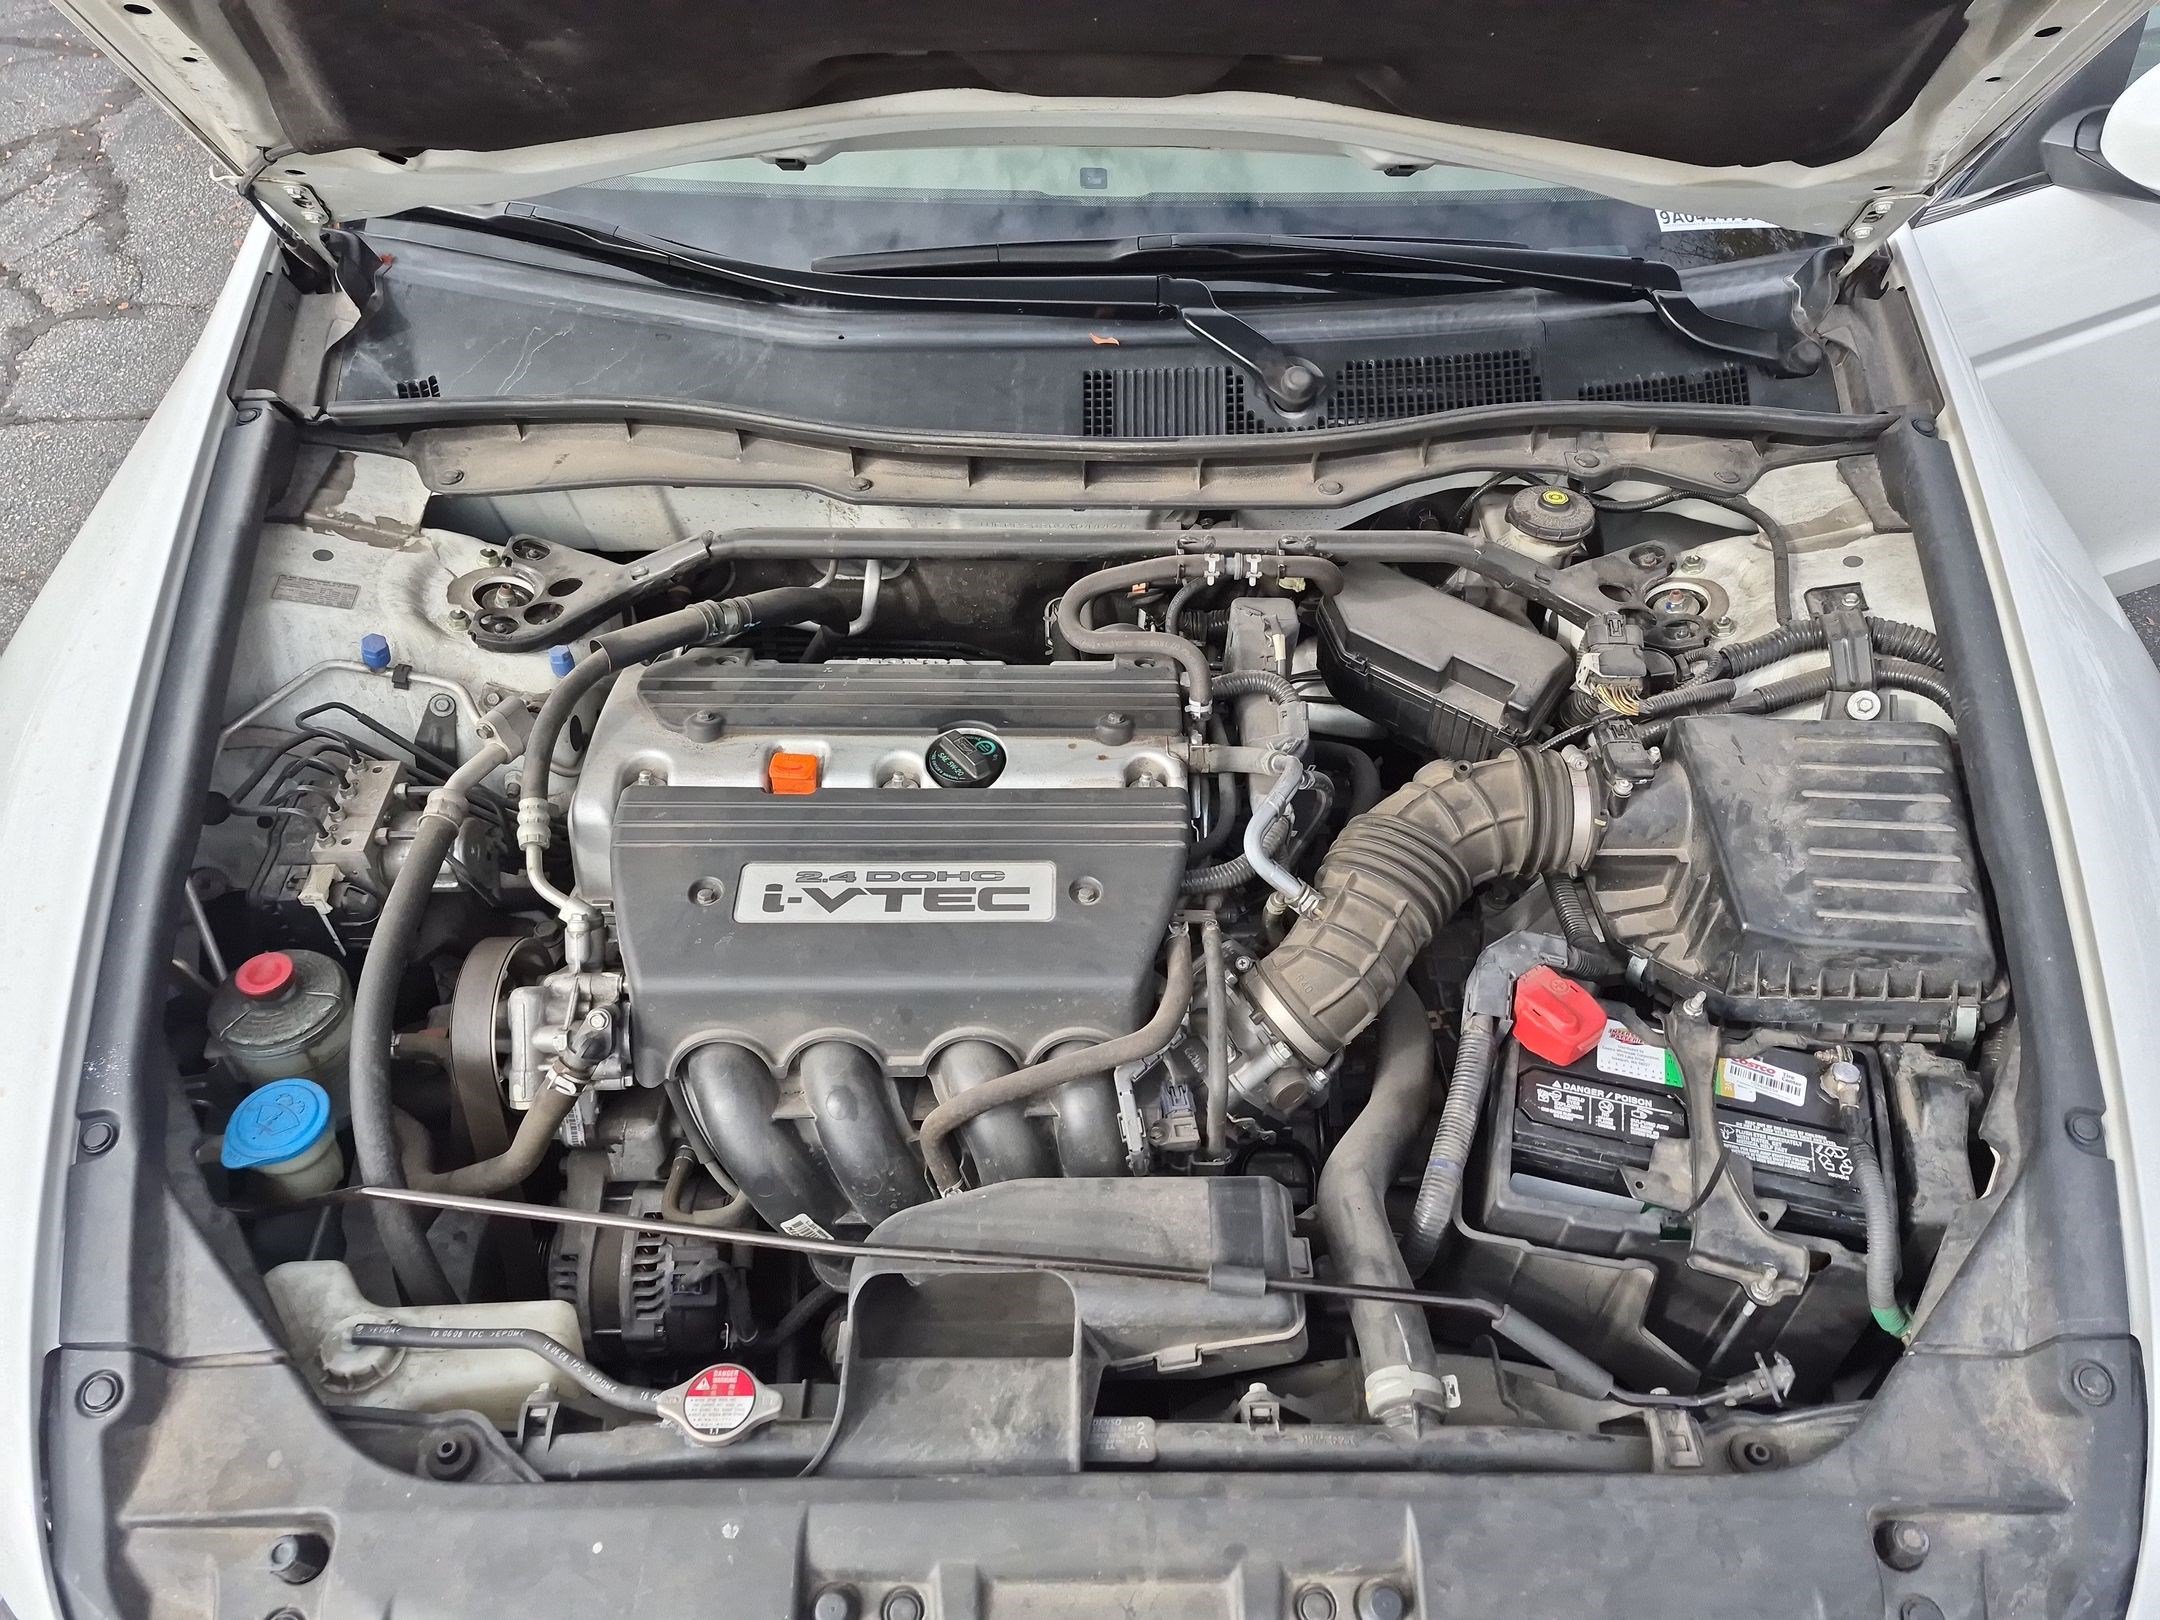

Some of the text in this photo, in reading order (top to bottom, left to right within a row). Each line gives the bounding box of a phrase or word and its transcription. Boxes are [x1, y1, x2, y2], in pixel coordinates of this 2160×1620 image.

[795, 870, 1006, 883] 2.4 DOHC
[762, 883, 1031, 913] i-VTEC
[1562, 1082, 1604, 1098] DANGER
[1614, 1094, 1653, 1108] POISON
[713, 1370, 739, 1378] DANGER
[1136, 1421, 1145, 1435] 2
[1137, 1436, 1149, 1449] A
